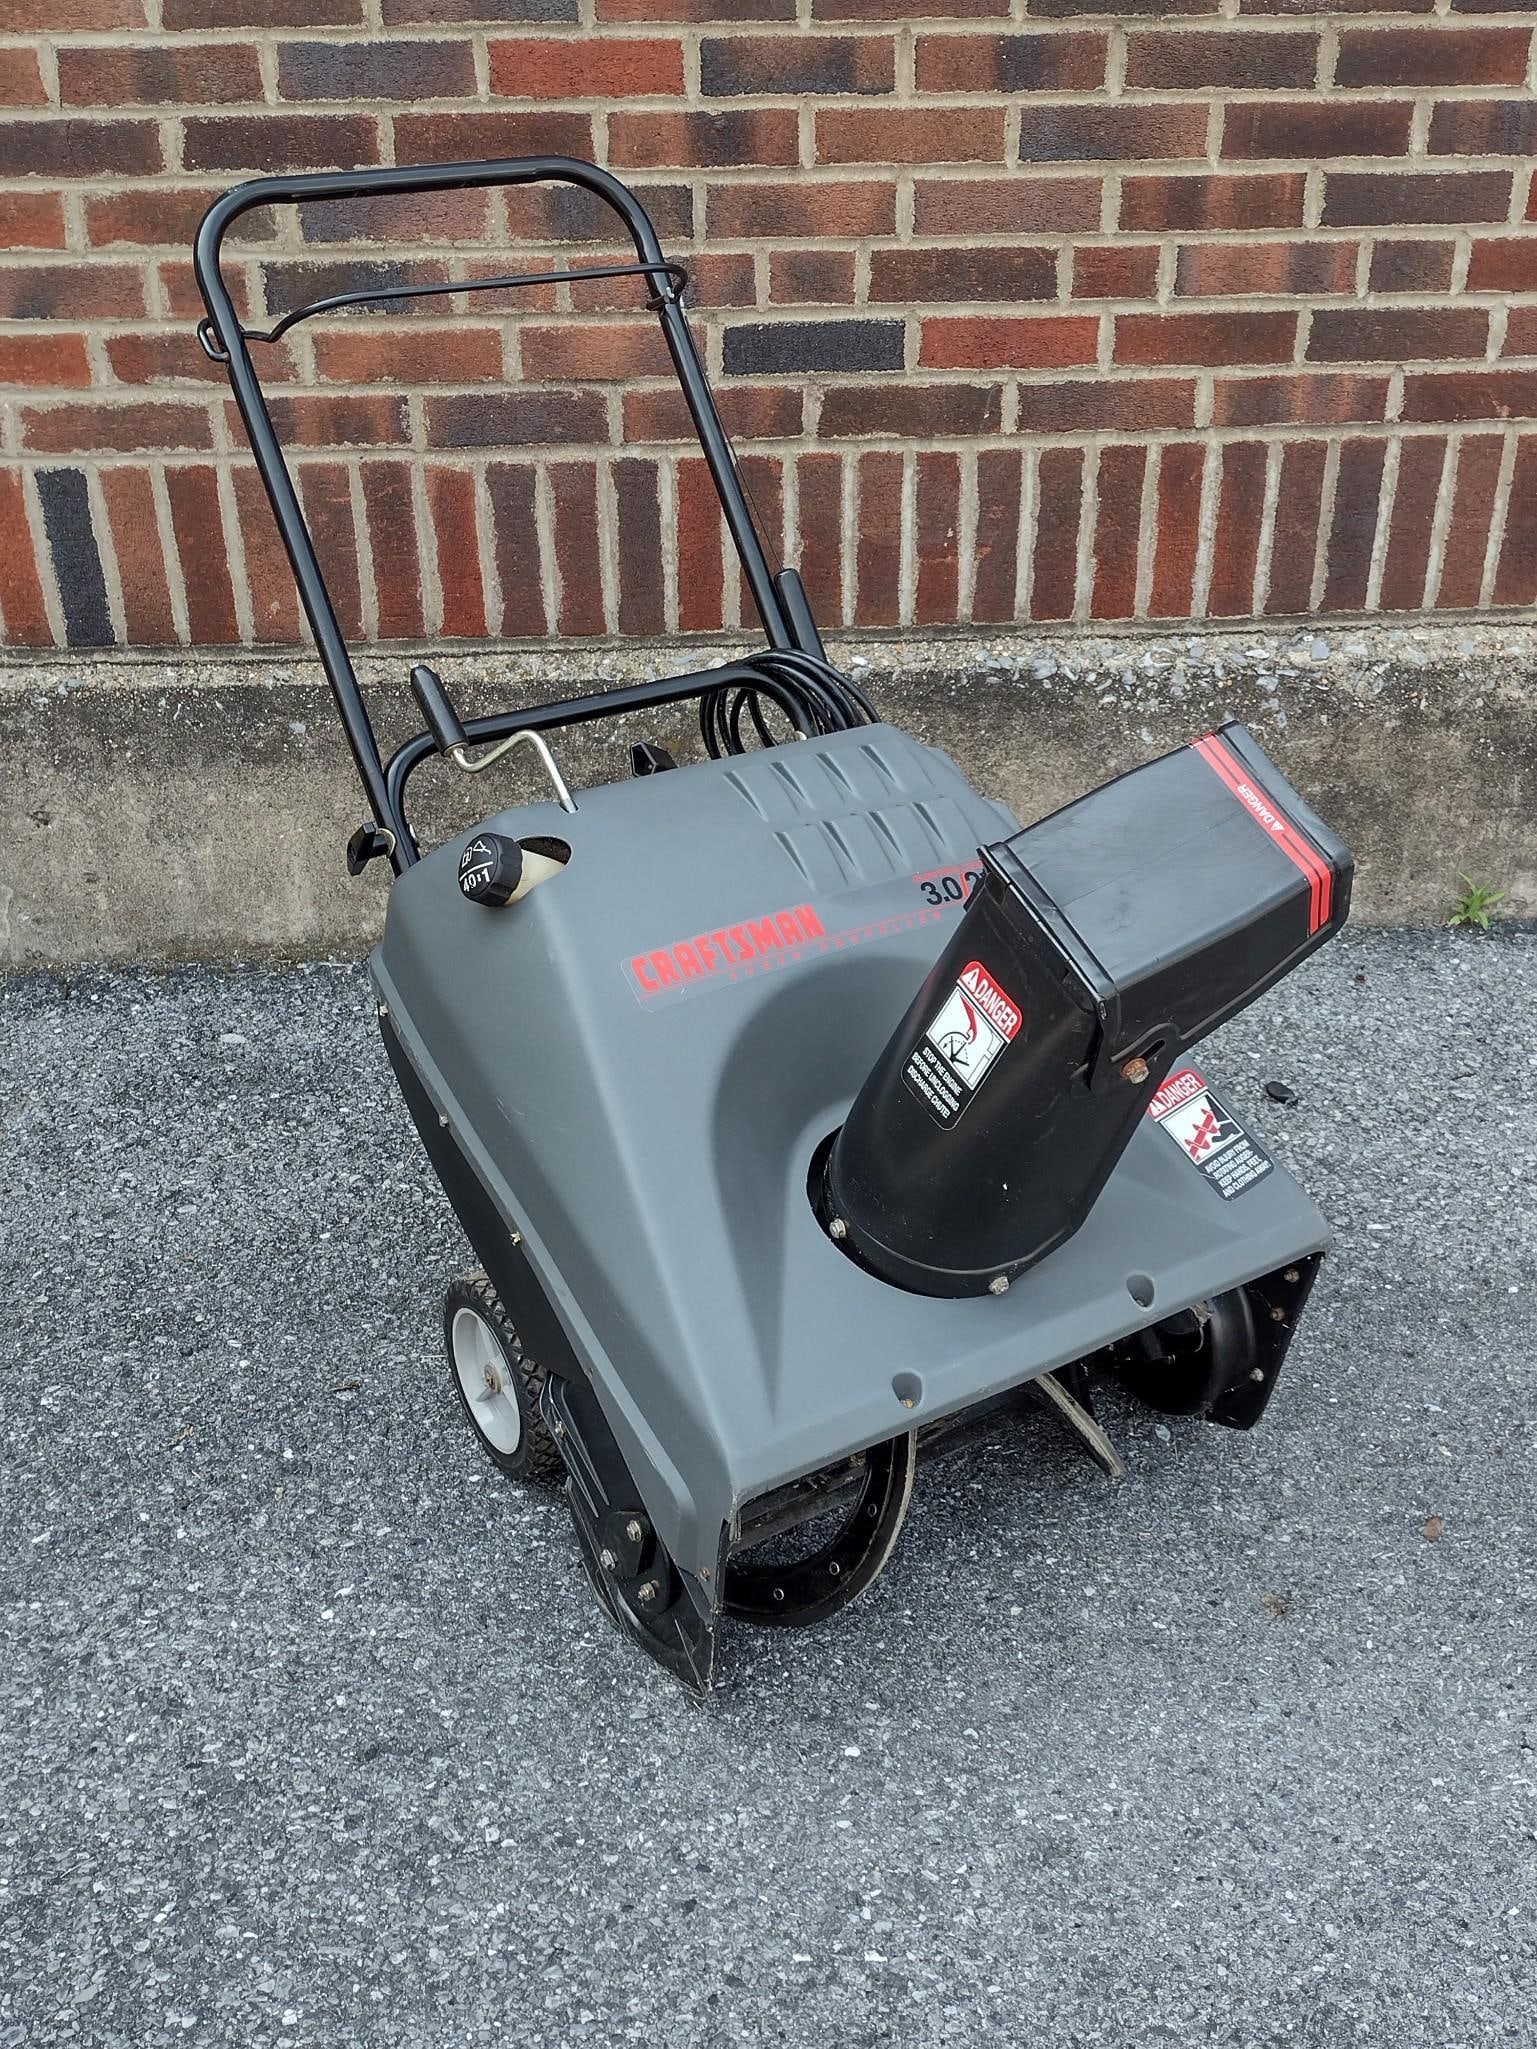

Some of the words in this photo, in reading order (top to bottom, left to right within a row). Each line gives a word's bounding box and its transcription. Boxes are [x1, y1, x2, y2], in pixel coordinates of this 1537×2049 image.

[1237, 784, 1275, 825] DANGER
[463, 868, 491, 892] 40:1
[631, 904, 825, 992] CRAFTSMAN
[974, 978, 1018, 1035] DANGER
[907, 1064, 935, 1100] DISCHARGE
[911, 1051, 932, 1078] BEFORE
[928, 1072, 960, 1112] UNCLOGGING
[922, 1046, 938, 1064] STOP
[934, 1060, 947, 1077] THE
[942, 1071, 963, 1096] ENGINE
[1160, 1073, 1203, 1109] DANGER
[1204, 1159, 1221, 1174] AVOID
[1217, 1148, 1237, 1164] INJURY
[1233, 1139, 1250, 1154] FROM
[1212, 1160, 1238, 1180] ROTATING
[1218, 1174, 1233, 1188] KEEP
[1222, 1185, 1236, 1198] AND
[1231, 1169, 1258, 1190] CLOTHING
